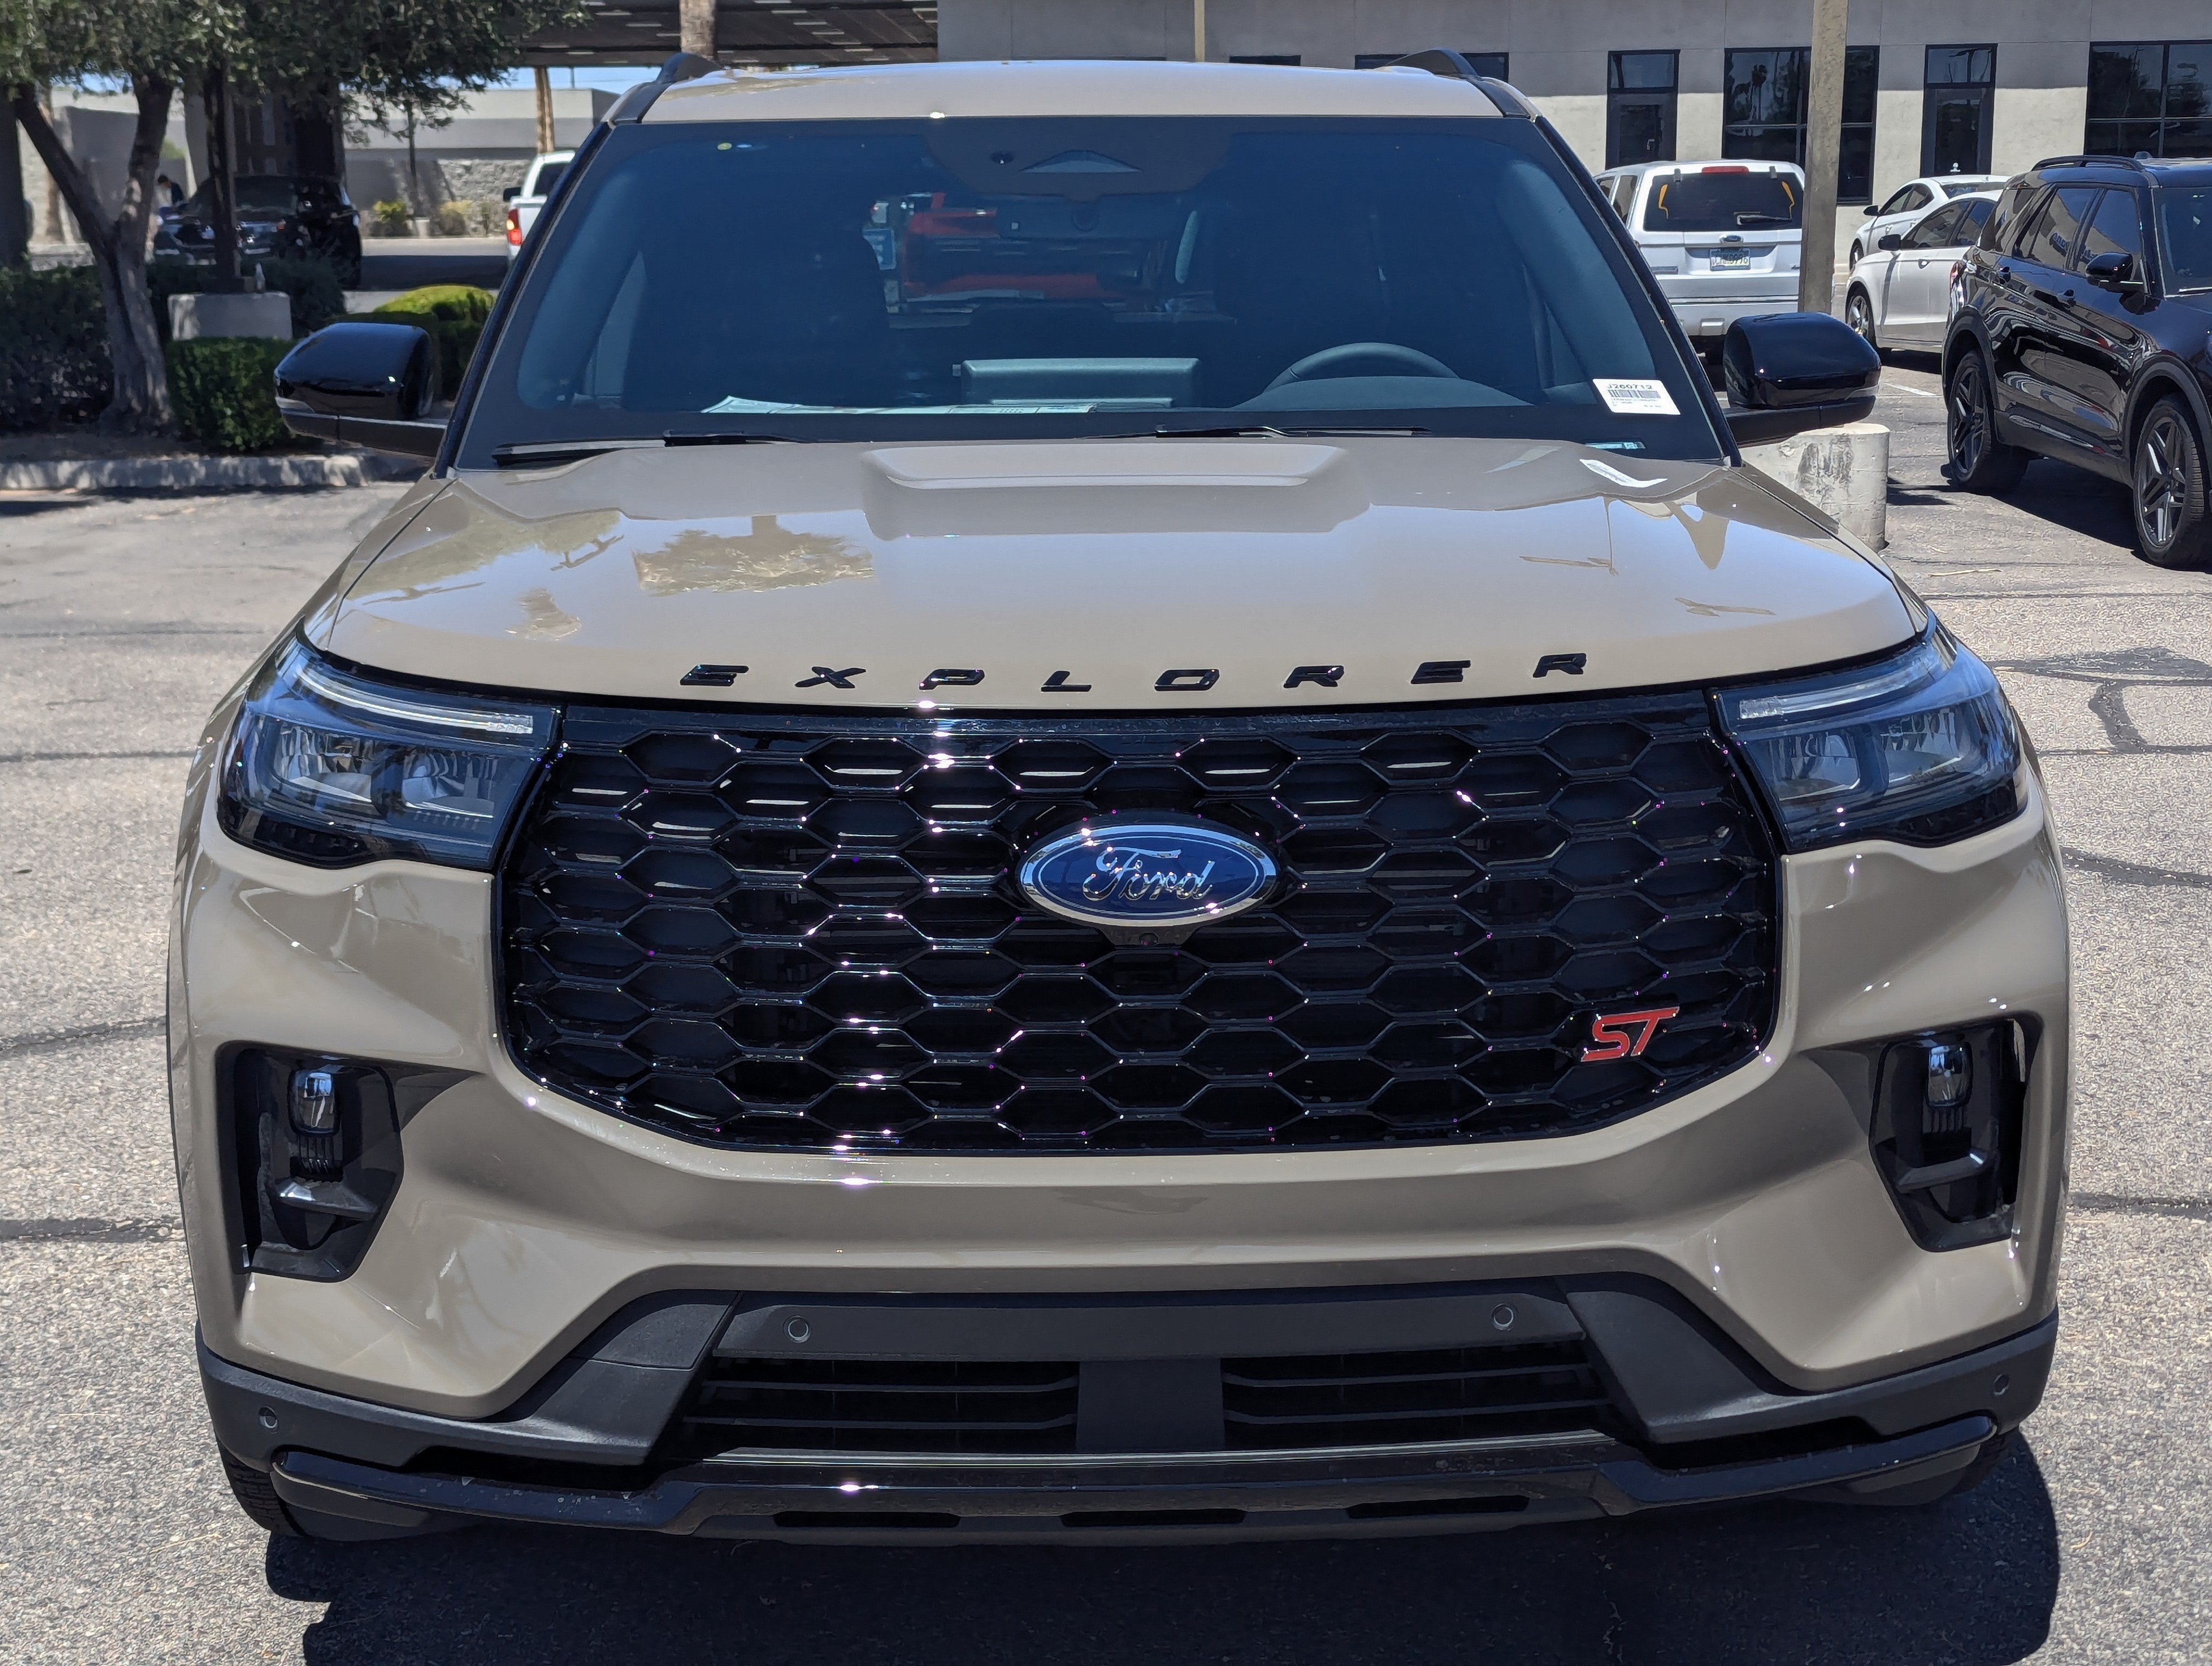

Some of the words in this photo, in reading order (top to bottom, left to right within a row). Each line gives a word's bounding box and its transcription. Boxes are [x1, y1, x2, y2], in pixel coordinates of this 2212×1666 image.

[680, 652, 1587, 692] EXPLORER
[1082, 847, 1215, 900] Ford
[1580, 1006, 1680, 1062] ST
